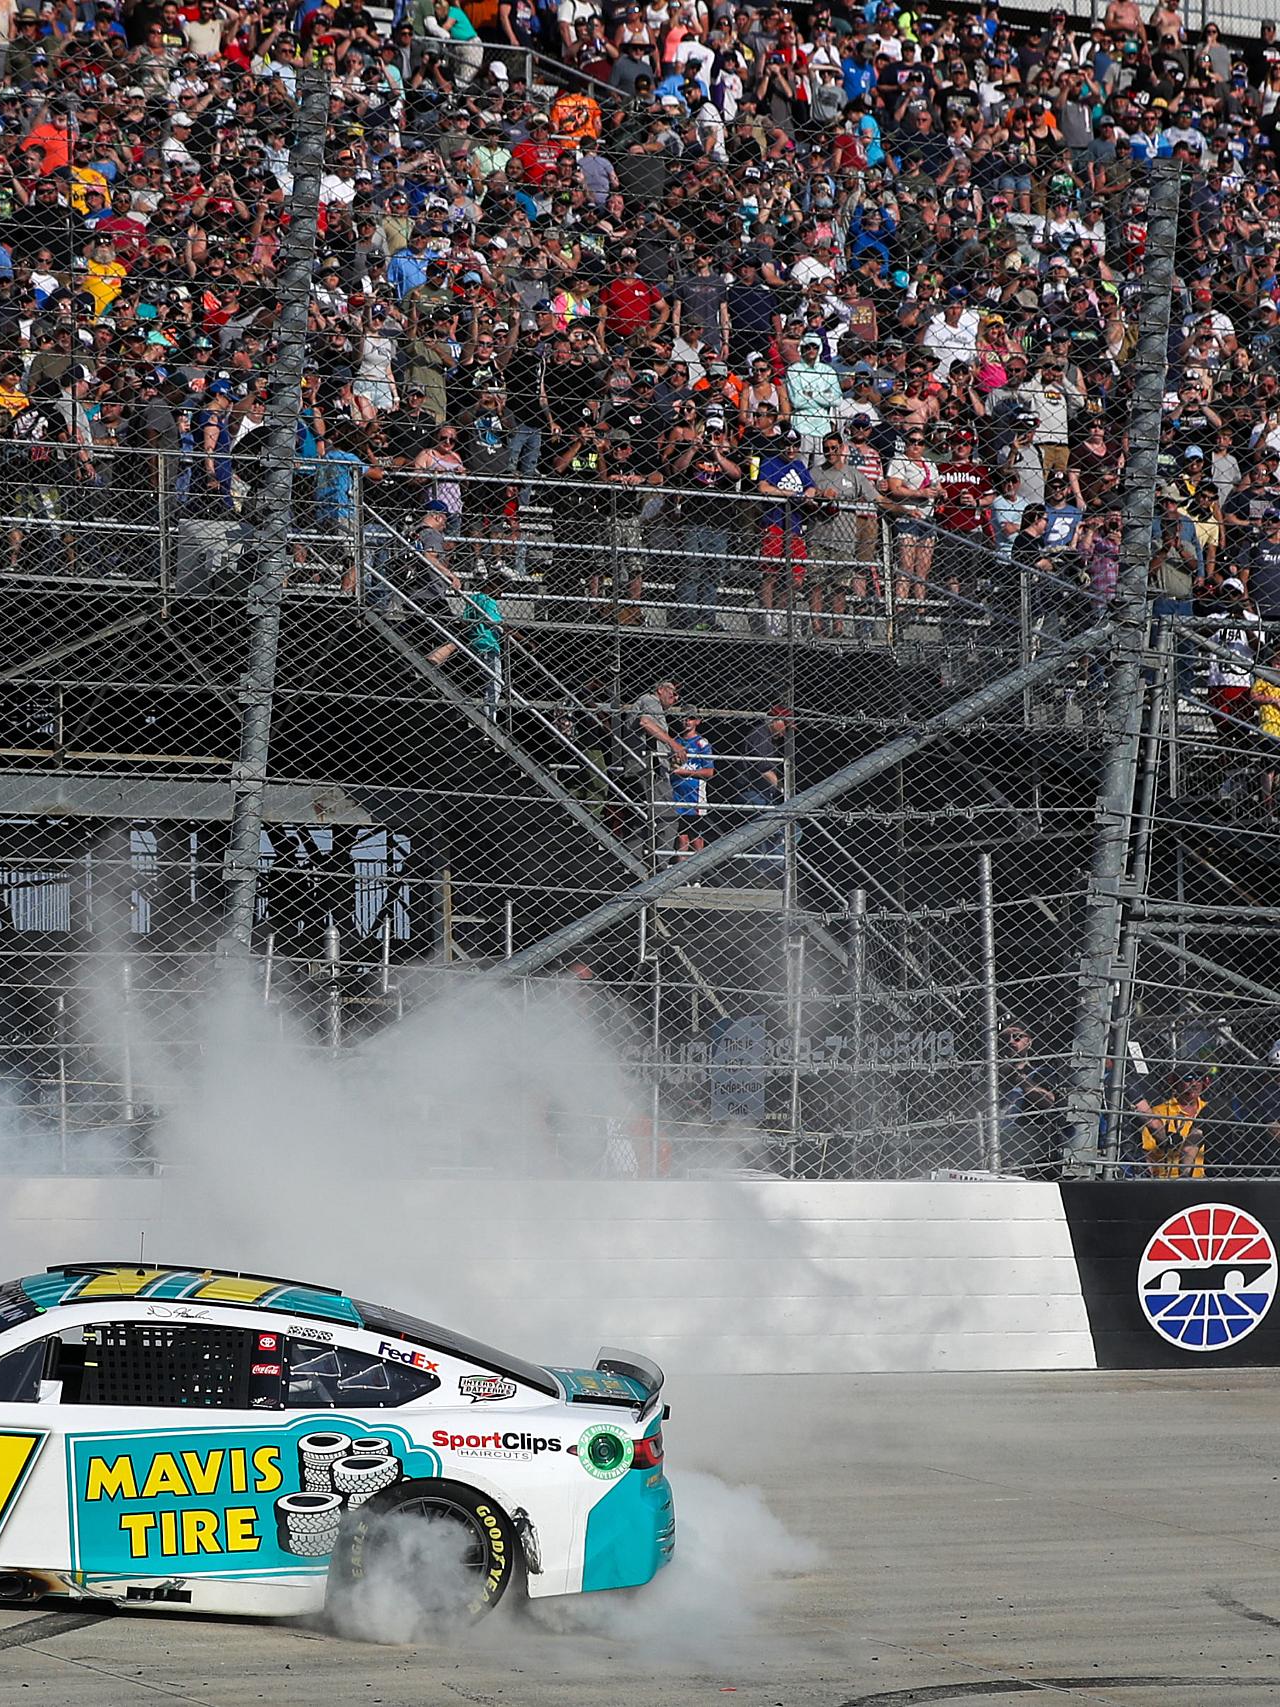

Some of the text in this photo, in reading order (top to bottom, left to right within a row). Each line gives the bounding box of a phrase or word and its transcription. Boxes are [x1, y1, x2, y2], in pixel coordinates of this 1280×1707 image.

[378, 1341, 440, 1373] FedEx
[462, 1379, 513, 1391] INTERSTATE
[464, 1385, 512, 1396] BATTERIES
[432, 1430, 562, 1455] SportClips
[460, 1450, 529, 1460] HAIRCUTS
[85, 1446, 283, 1501] MAVIS
[120, 1505, 262, 1559] TIRE
[351, 1521, 369, 1579] EAGLE
[468, 1505, 507, 1615] GOODYEAR
